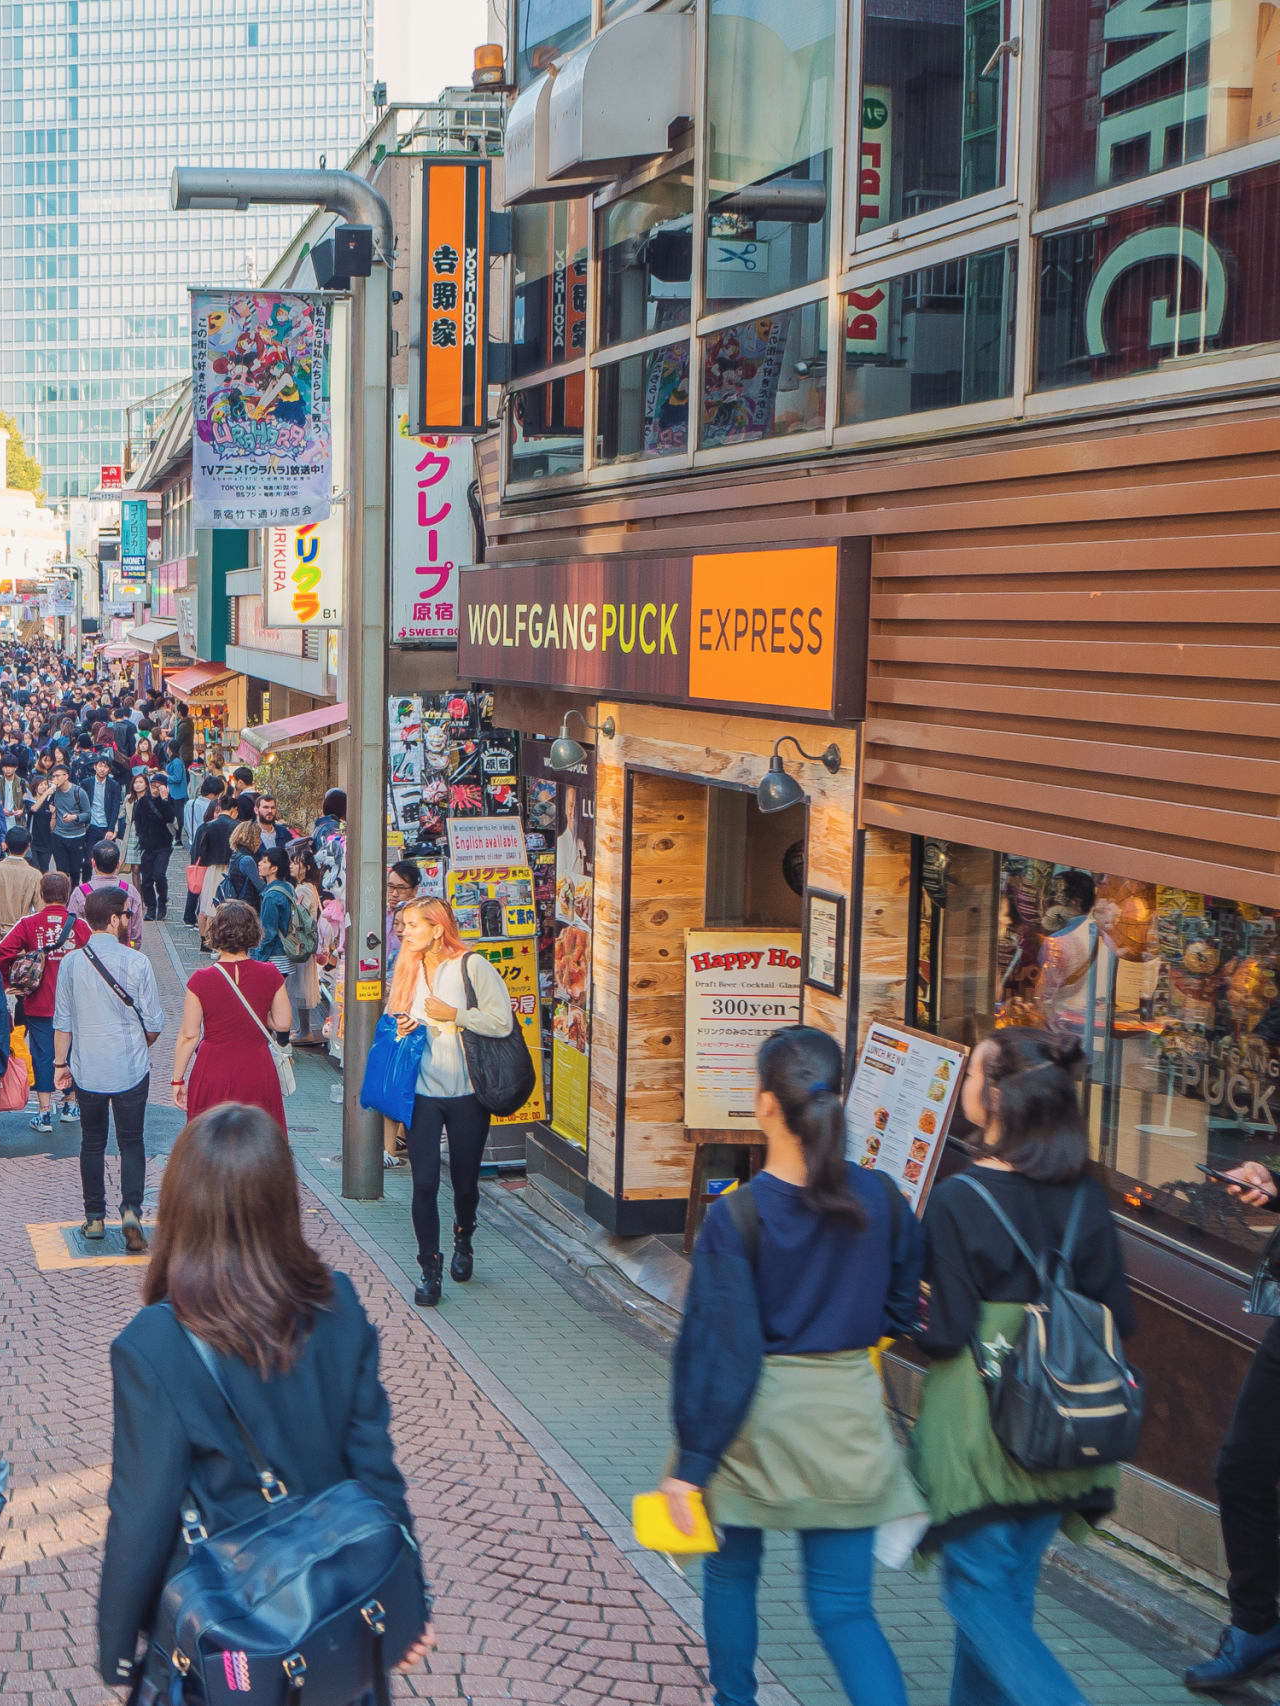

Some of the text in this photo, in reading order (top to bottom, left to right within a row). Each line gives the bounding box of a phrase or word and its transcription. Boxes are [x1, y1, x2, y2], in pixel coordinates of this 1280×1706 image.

[431, 244, 458, 348] 吉野家
[213, 505, 312, 520] 原宿竹下通り商店会
[415, 451, 454, 599] クレープ
[122, 557, 145, 565] MONEY
[323, 608, 337, 619] B1
[412, 602, 453, 621] 原宿
[409, 628, 445, 637] SWEET
[467, 602, 824, 655] WOLFGANG PUCK EXPRESS
[484, 757, 510, 771] 原宿
[455, 835, 518, 851] English available
[507, 908, 535, 925] ご案内
[691, 951, 765, 973] Happy
[695, 980, 716, 988] Draft
[1182, 1059, 1277, 1127] PUCK
